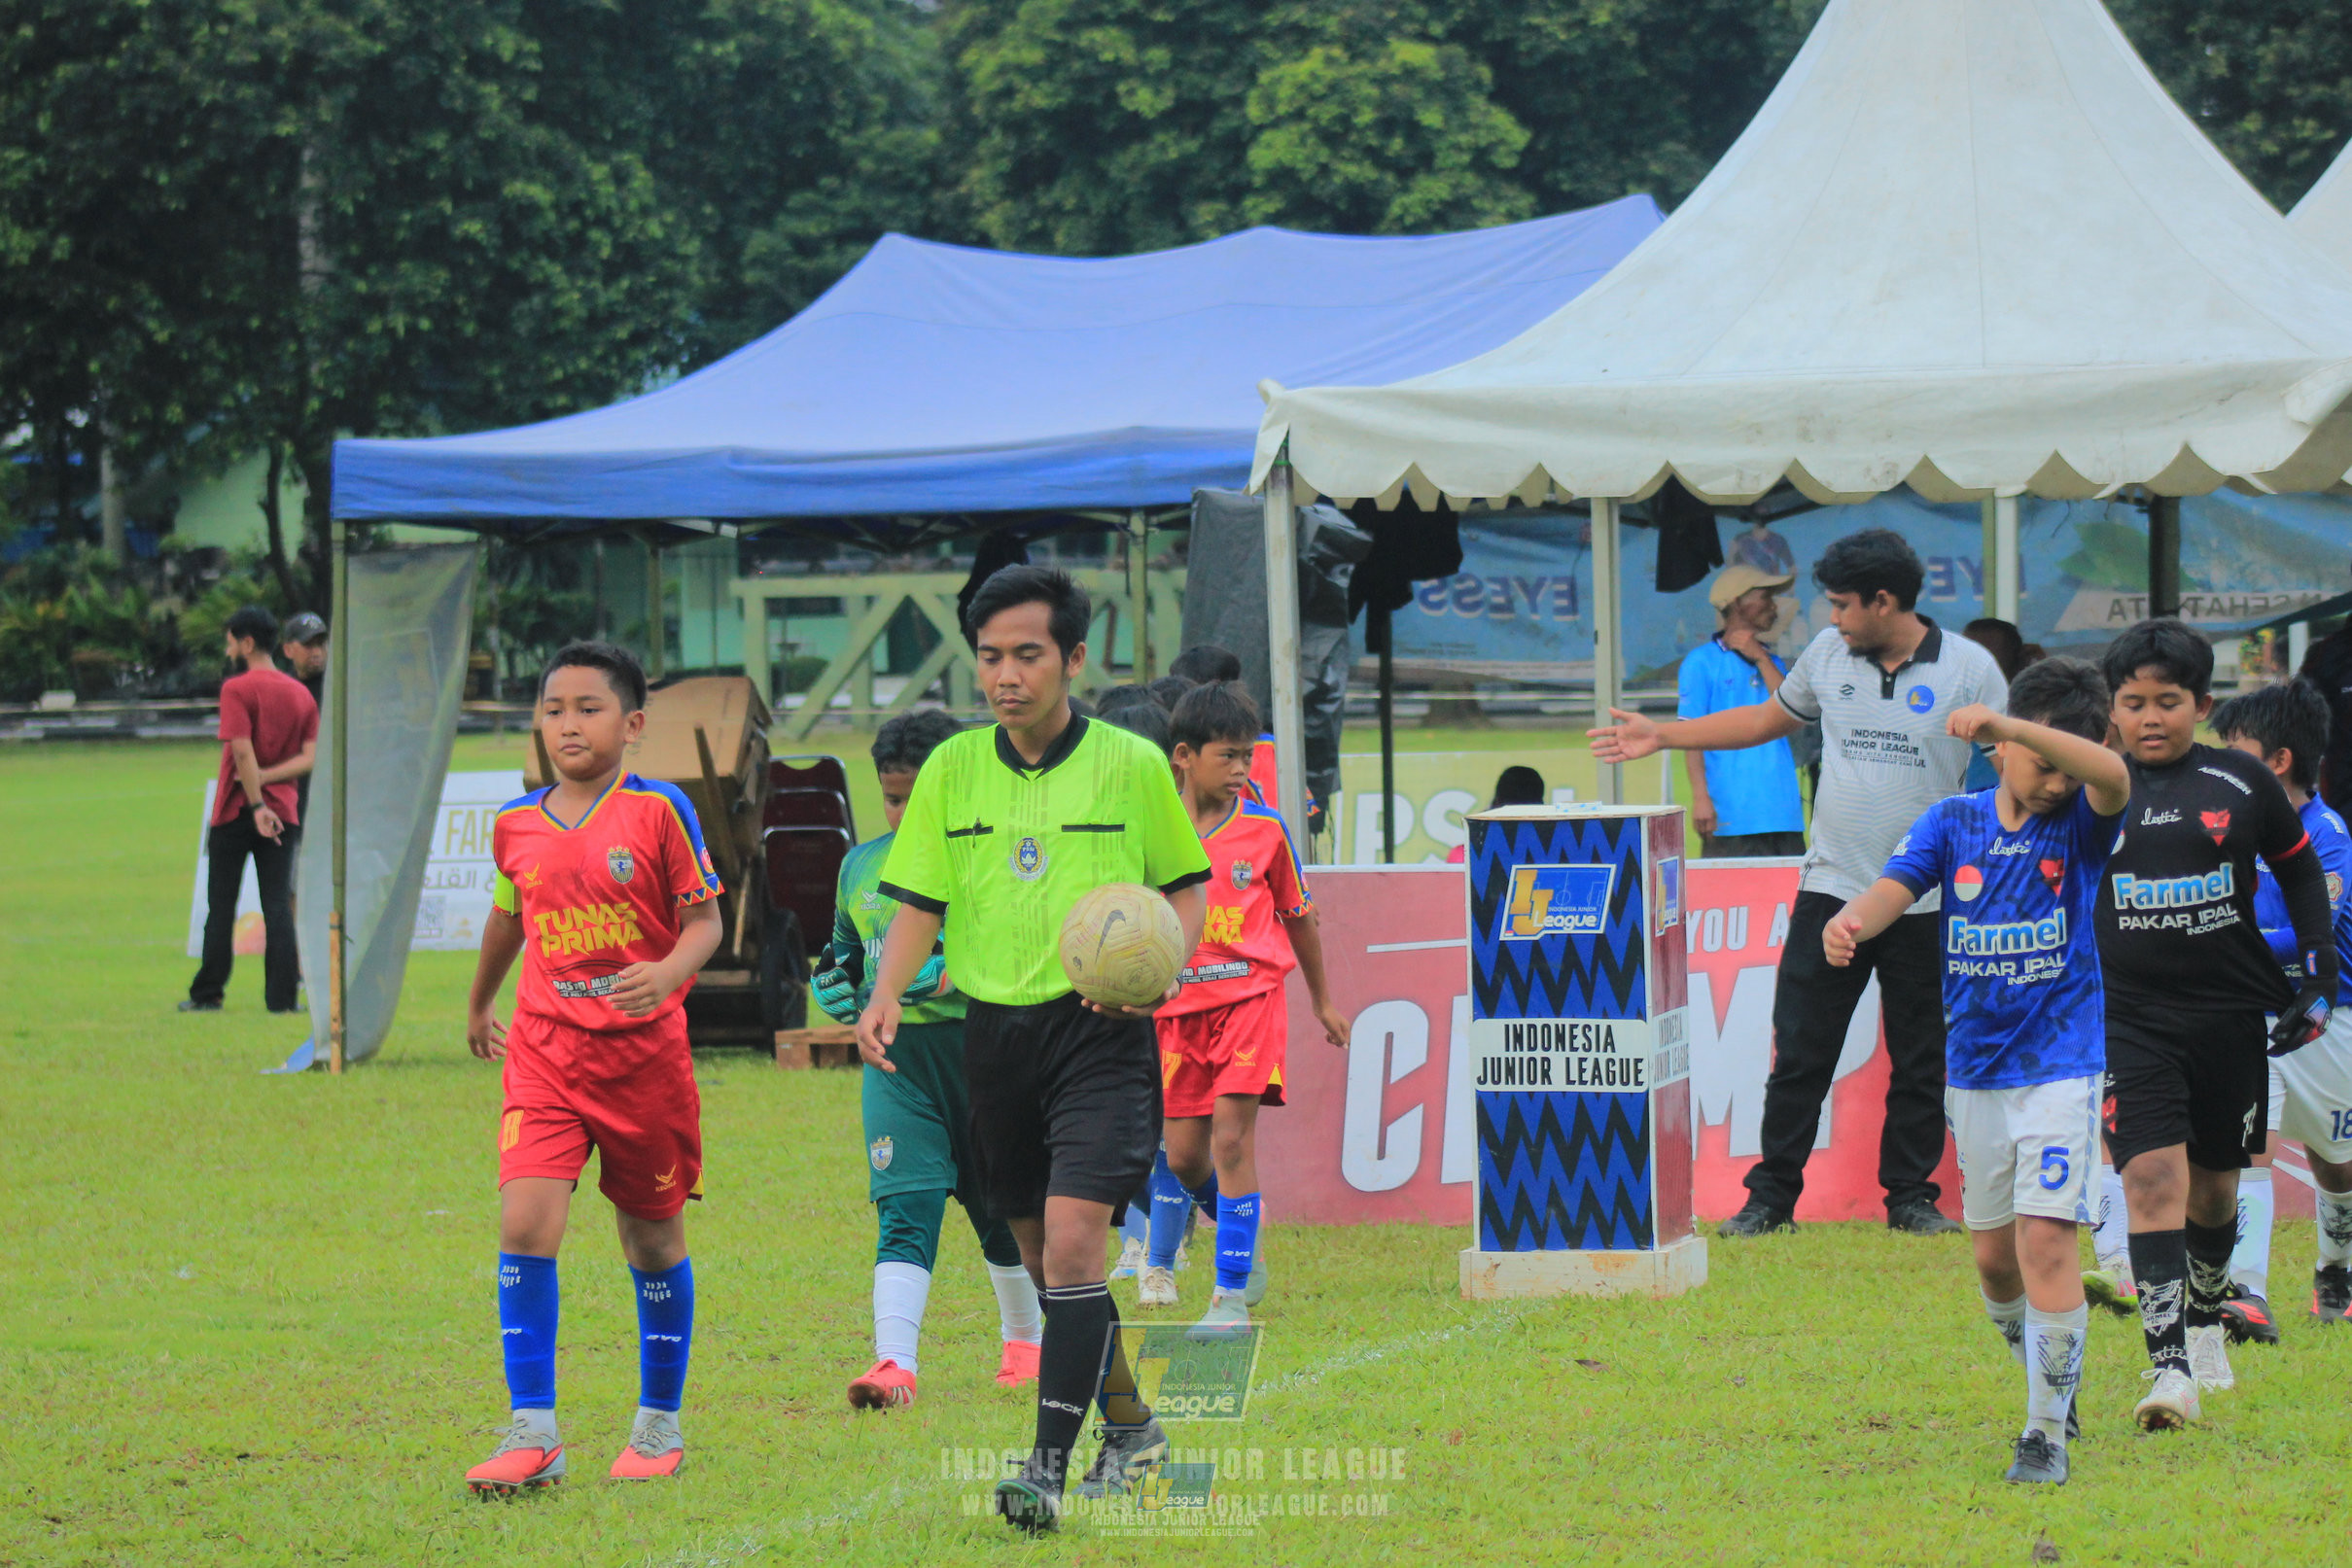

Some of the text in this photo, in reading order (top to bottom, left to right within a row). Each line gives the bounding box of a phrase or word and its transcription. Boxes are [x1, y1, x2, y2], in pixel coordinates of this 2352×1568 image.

[1851, 729, 1909, 743] INDONESIA
[1881, 742, 1919, 755] LEAGUE
[2112, 862, 2234, 909] Farmel
[534, 902, 638, 939] TUNAS
[1532, 911, 1597, 931] League
[1687, 905, 1749, 954] YOU
[1948, 907, 2067, 956] Farmel
[2119, 903, 2238, 930] PAKAR IPAL
[2187, 916, 2241, 935] INDONESIA
[538, 922, 645, 958] PRIMA
[1948, 953, 2066, 977] PAKAR IPAL
[1504, 1023, 1617, 1054] INDONESIA
[1477, 1057, 1645, 1087] JUNIOR LEAGUE
[2039, 1146, 2069, 1190] 5
